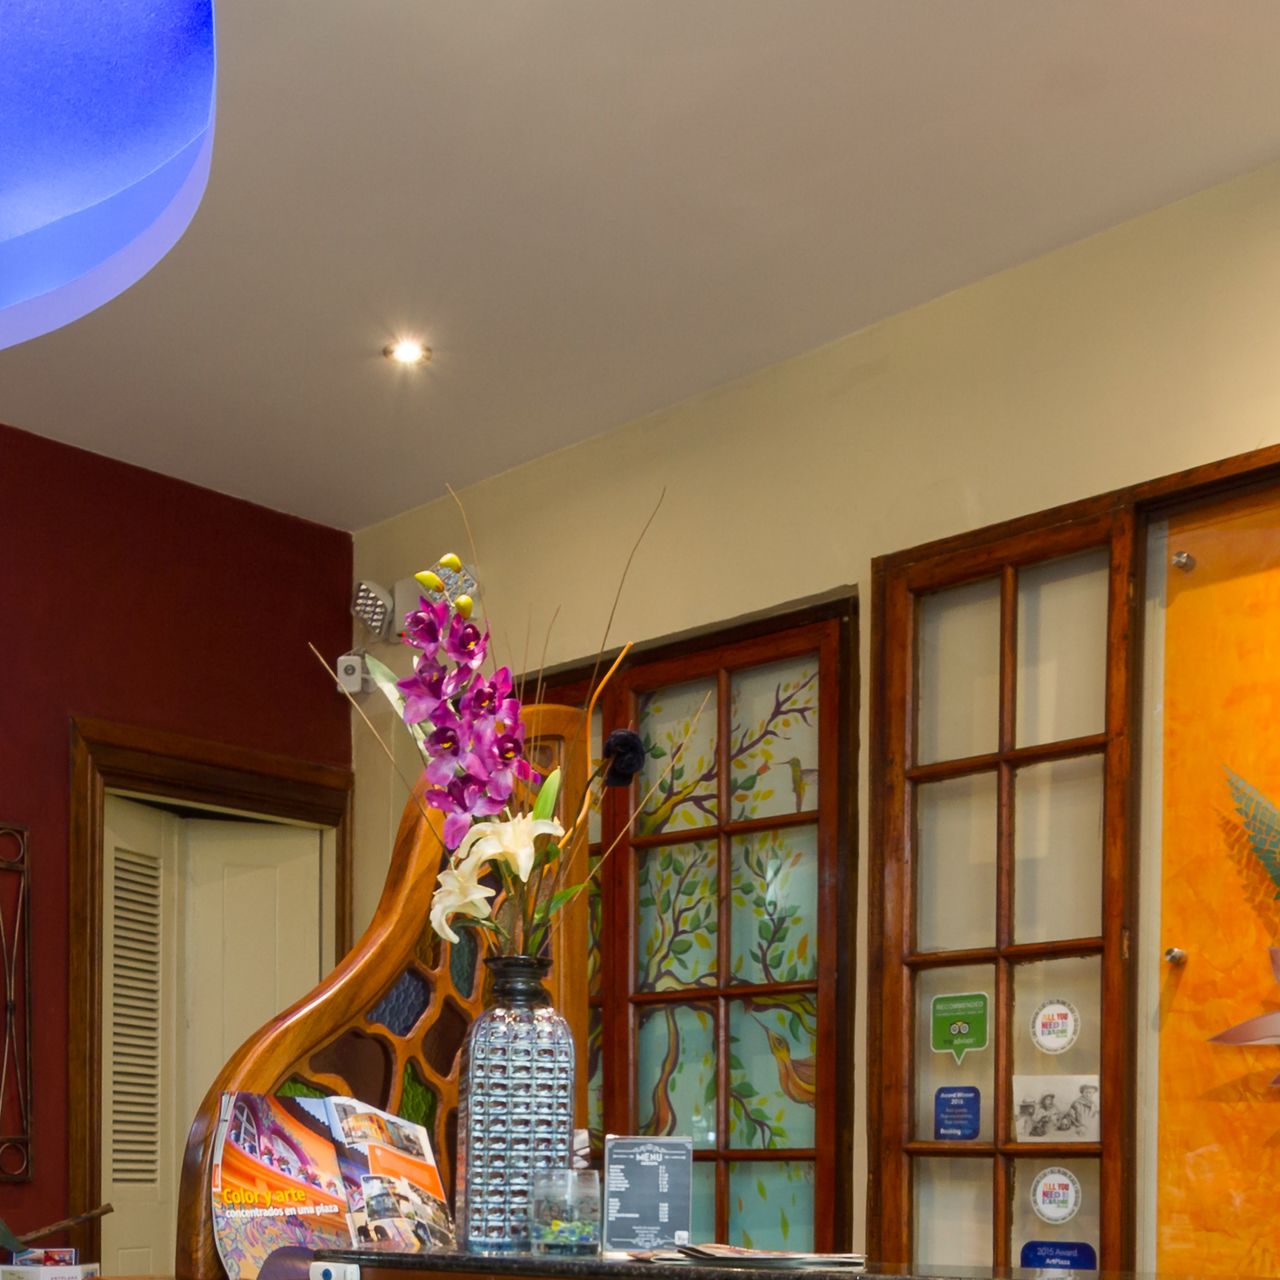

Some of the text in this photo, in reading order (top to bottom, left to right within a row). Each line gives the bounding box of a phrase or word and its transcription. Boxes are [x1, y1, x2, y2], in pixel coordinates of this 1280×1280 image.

[636, 1153, 663, 1162] MENU
[223, 1188, 306, 1206] Color y arte
[226, 1203, 339, 1218] concentrados en una plaza
